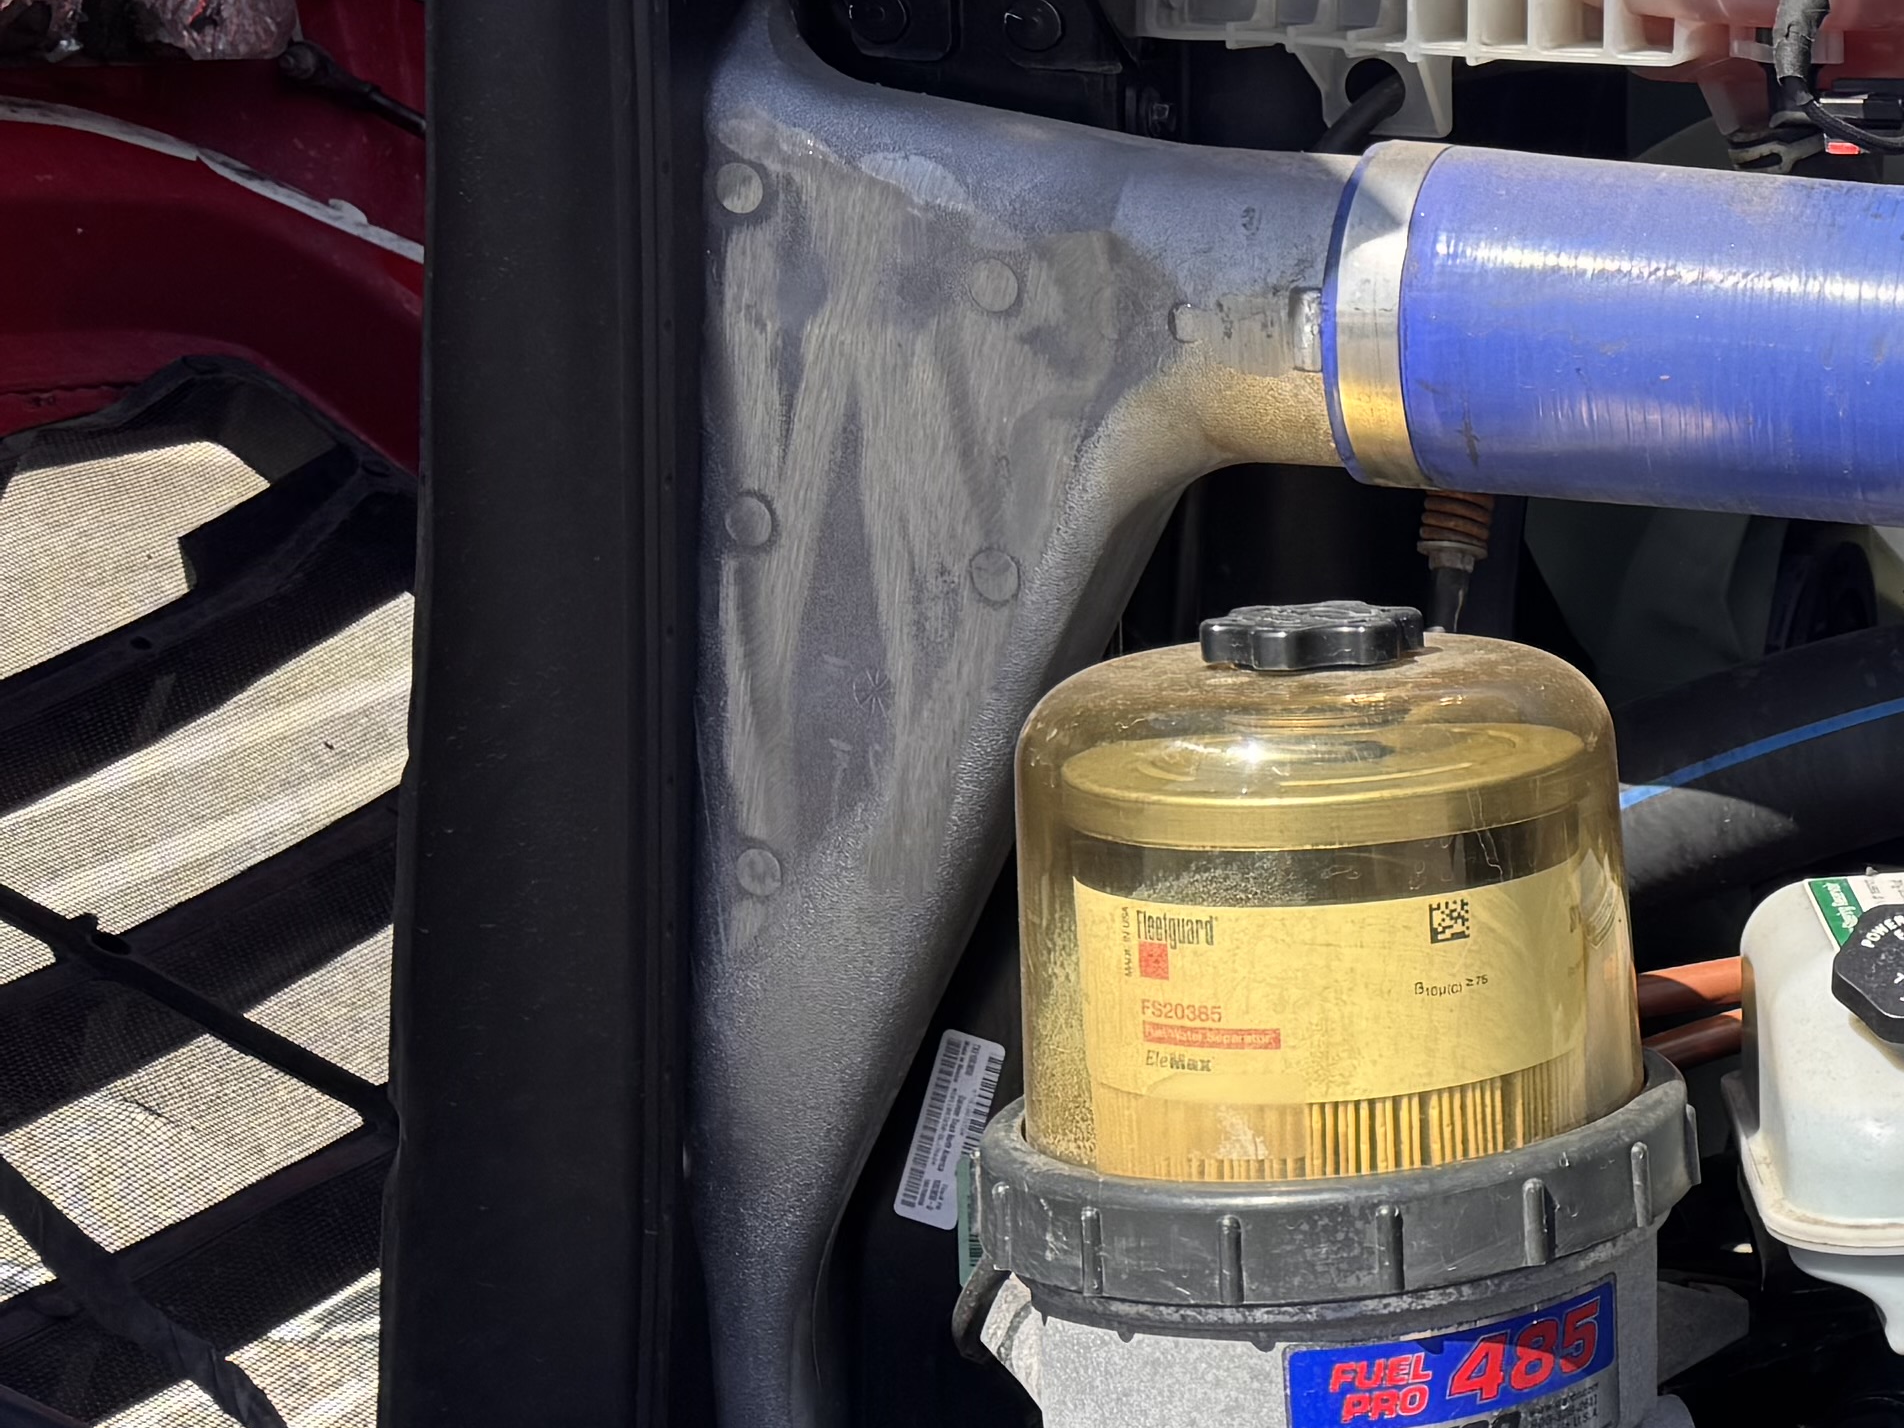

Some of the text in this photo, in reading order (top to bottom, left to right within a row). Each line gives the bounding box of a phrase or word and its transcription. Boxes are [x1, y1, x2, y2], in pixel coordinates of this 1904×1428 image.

[1121, 905, 1131, 929] USA
[1136, 909, 1215, 950] Fleetguard
[1145, 1049, 1212, 1072] EleMax
[1329, 1352, 1432, 1393] FUEL
[1446, 1296, 1601, 1405] 485
[1340, 1384, 1430, 1424] PRO
